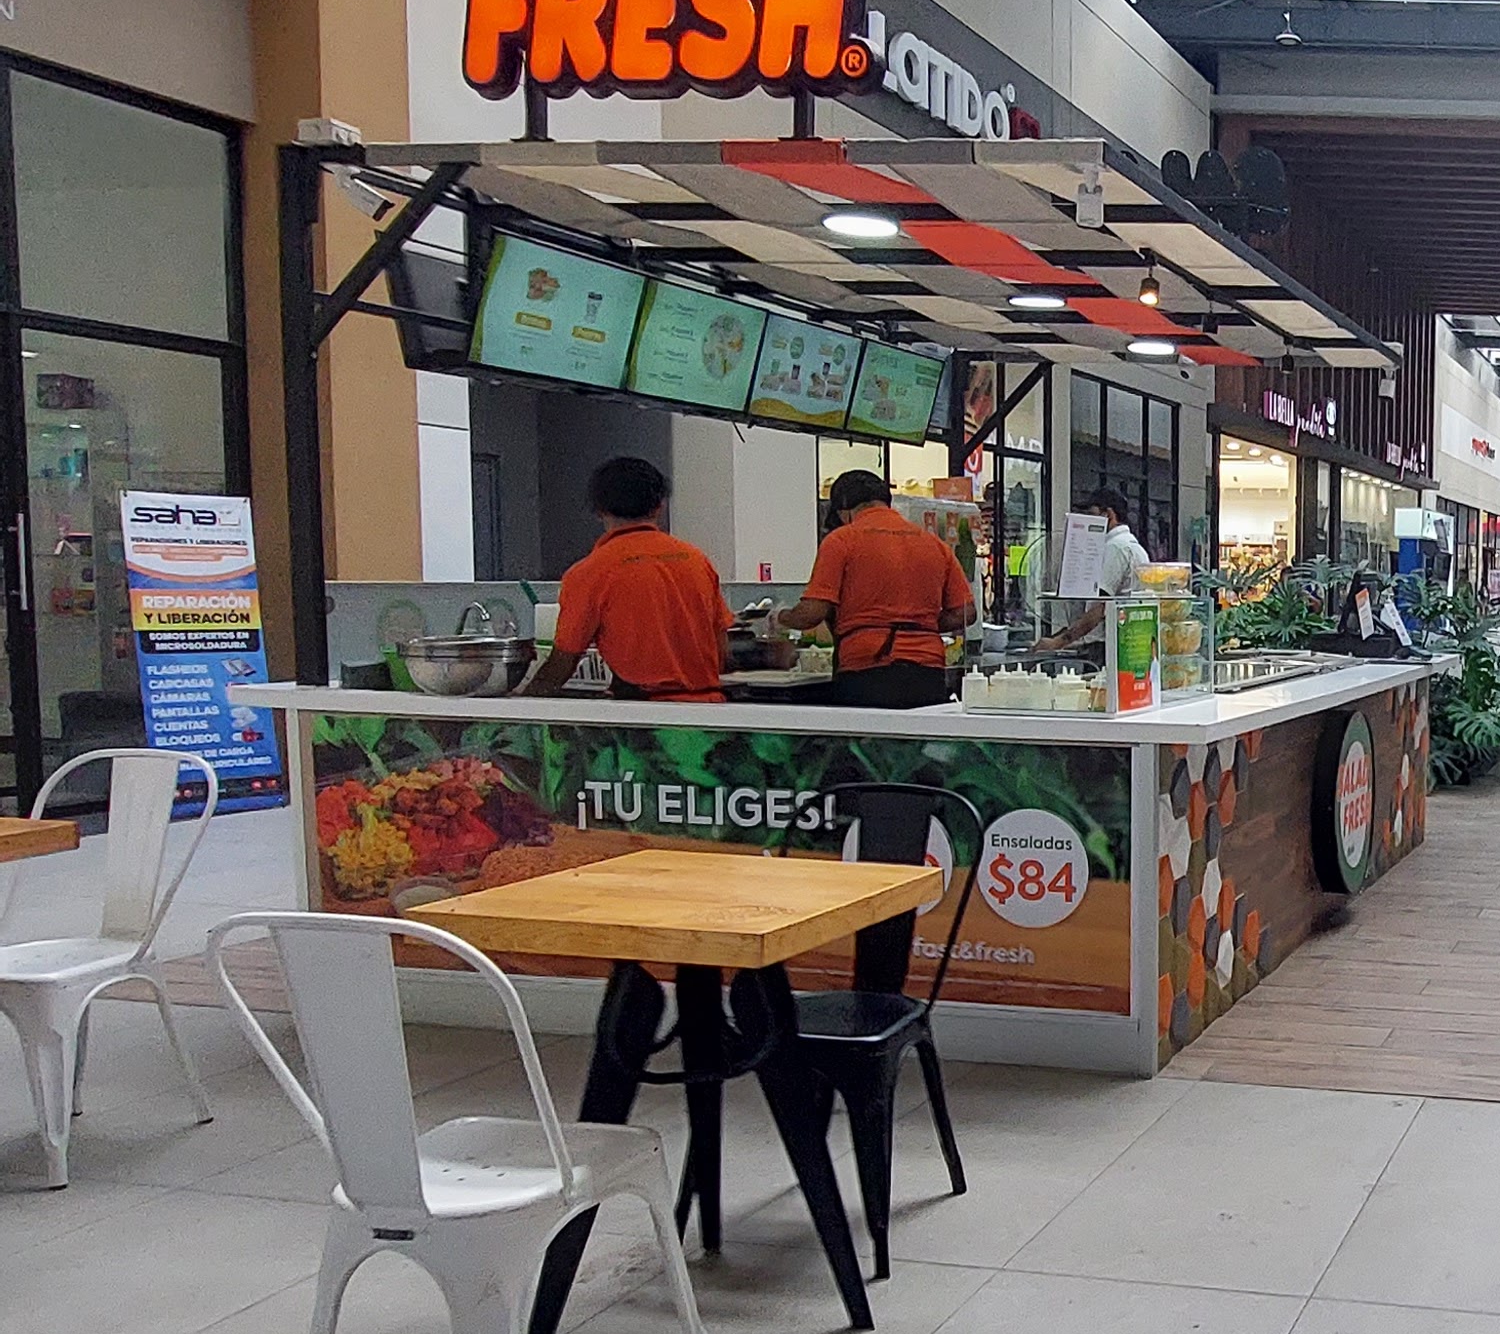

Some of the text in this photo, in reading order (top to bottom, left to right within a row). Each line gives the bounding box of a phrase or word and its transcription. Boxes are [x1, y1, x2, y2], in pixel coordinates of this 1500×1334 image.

[142, 593, 251, 609] REPARACIÓN
[143, 610, 251, 624] Y LIBERACIÓN
[152, 705, 220, 719] PANTALLAS
[576, 772, 839, 832] ¡TÚ ELIGES!
[990, 833, 1073, 852] Ensaladas
[988, 853, 1078, 905] $84
